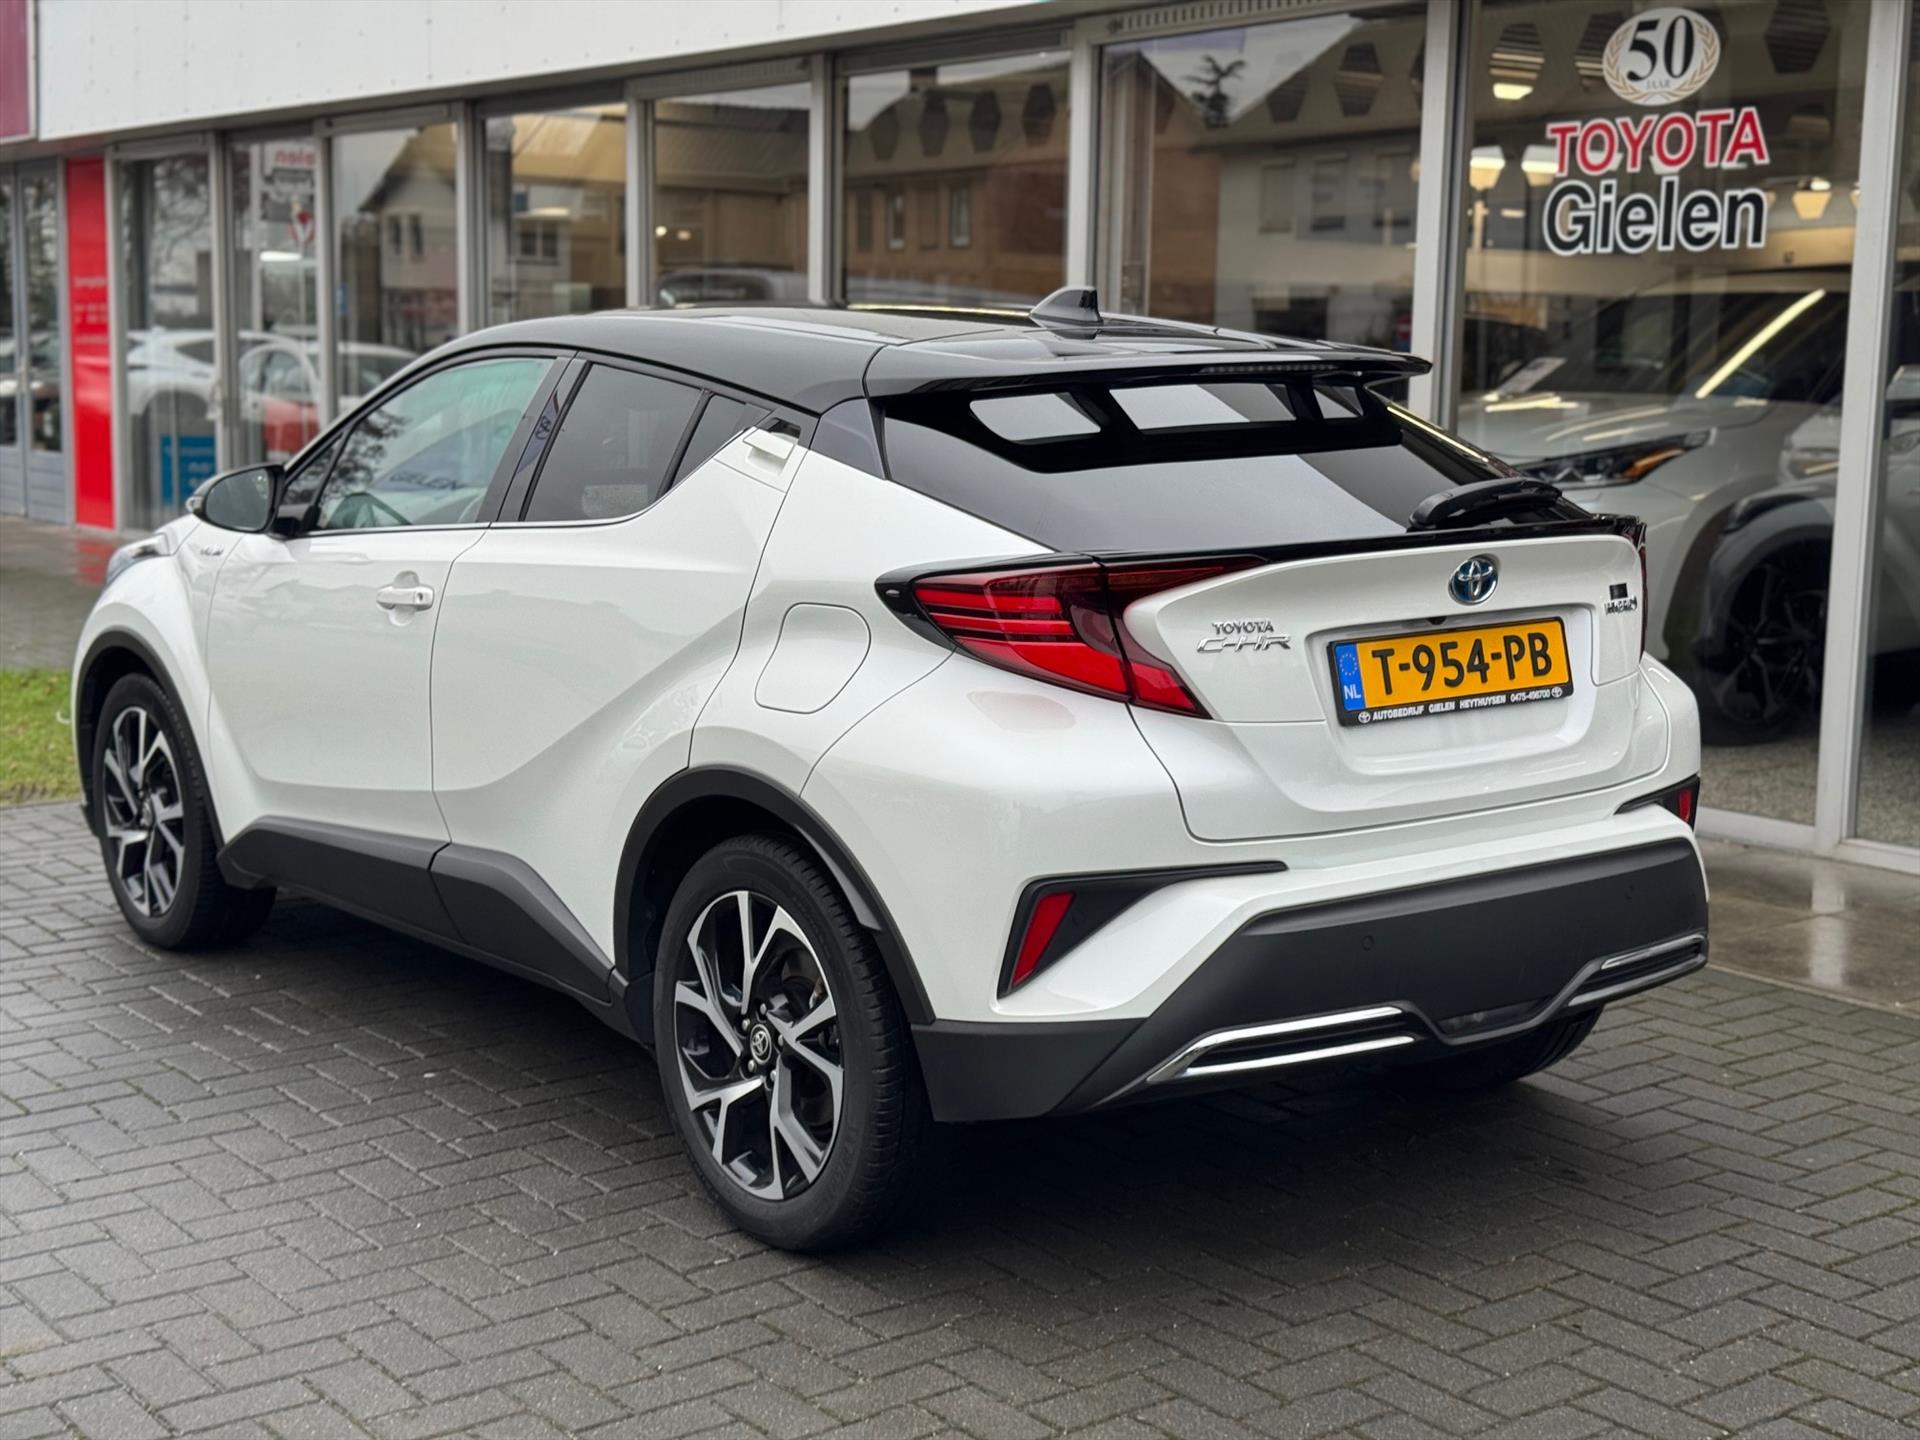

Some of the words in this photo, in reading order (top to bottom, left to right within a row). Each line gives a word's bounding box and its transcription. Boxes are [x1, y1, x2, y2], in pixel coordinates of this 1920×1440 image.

[1627, 15, 1694, 81] 50
[1546, 107, 1770, 176] TOYOTA
[1543, 175, 1767, 256] Gielen
[1197, 635, 1291, 653] C-HR
[1212, 620, 1275, 635] TOYOTA
[1371, 632, 1553, 695] T-954-PB
[1343, 684, 1361, 700] NL
[1372, 705, 1424, 721] AUTOBEDRIJF
[1429, 702, 1455, 713] GIELEN
[1460, 694, 1506, 709] HEYTHUYSEN
